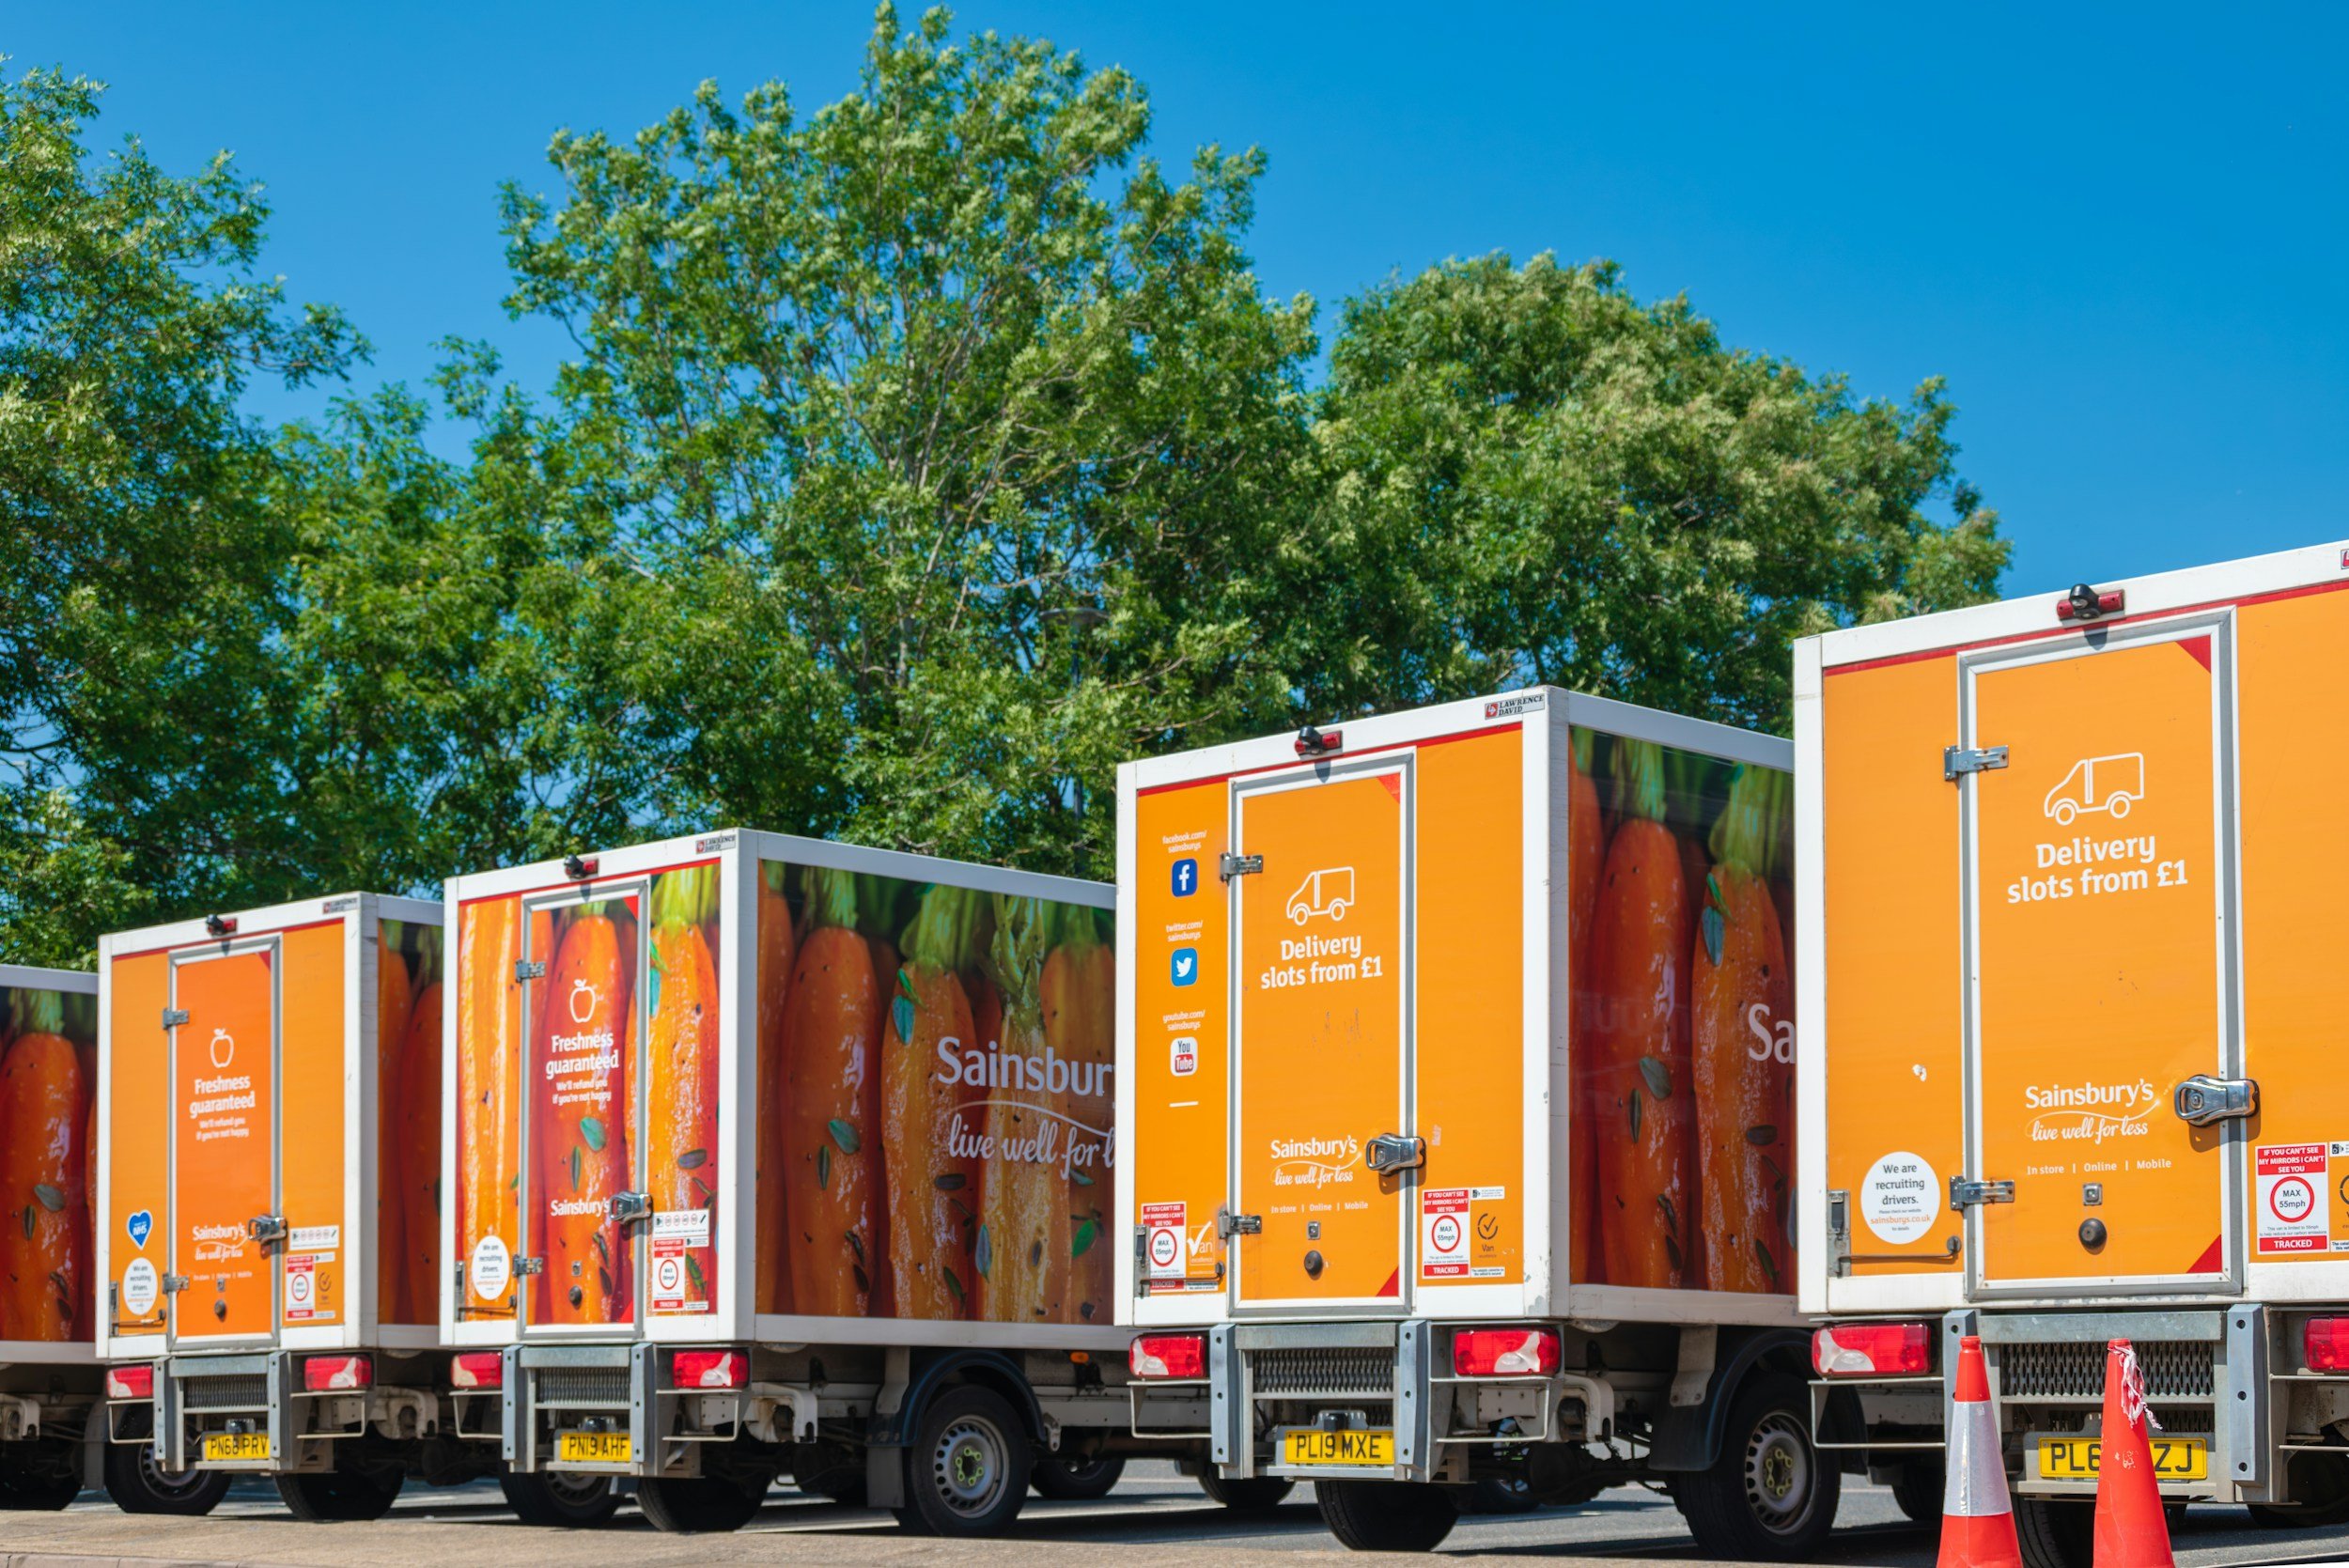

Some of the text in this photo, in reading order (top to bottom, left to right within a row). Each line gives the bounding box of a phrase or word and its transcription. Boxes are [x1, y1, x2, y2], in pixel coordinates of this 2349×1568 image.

[1499, 706, 1522, 715] DAVID
[1500, 695, 1544, 708] LAWRENCE
[2035, 835, 2155, 868] Delivery
[2007, 859, 2188, 904] slots from £1
[1280, 935, 1361, 960] Delivery
[1261, 955, 1383, 989] slots from £1
[551, 1032, 614, 1053] Freshness
[1177, 1040, 1190, 1053] You
[546, 1049, 619, 1079] guaranteed
[937, 1036, 1115, 1096] Sainsbur
[1175, 1057, 1193, 1071] Tube
[194, 1076, 251, 1094] Freshness
[2025, 1078, 2155, 1109] Sainsbury's
[189, 1090, 256, 1119] guaranteed
[2031, 1115, 2149, 1144] live well for less
[948, 1113, 995, 1158] live
[1002, 1119, 1058, 1164] well
[1061, 1126, 1100, 1180] for
[1270, 1135, 1358, 1158] Sainsbury's
[1275, 1165, 1354, 1189] live well for less
[1883, 1165, 1917, 1174] We are
[2027, 1158, 2171, 1175] In store Online Mobile
[1875, 1178, 1925, 1190] recruiting
[551, 1197, 610, 1218] Sainsbury's
[1309, 1203, 1332, 1212] Online
[1345, 1201, 1368, 1210] Mobile
[1882, 1195, 1919, 1205] drivers.
[2279, 1201, 2306, 1209] 55mph
[132, 1223, 148, 1235] NHS
[193, 1221, 245, 1241] Sainsbury's
[1482, 1244, 1494, 1252] Van
[2274, 1239, 2312, 1249] TRACKED
[242, 1436, 269, 1454] PRV
[569, 1436, 629, 1457] PN19 AHF
[1297, 1435, 1382, 1458] PL19 MXE
[2050, 1443, 2193, 1472] PL6 ZJ
